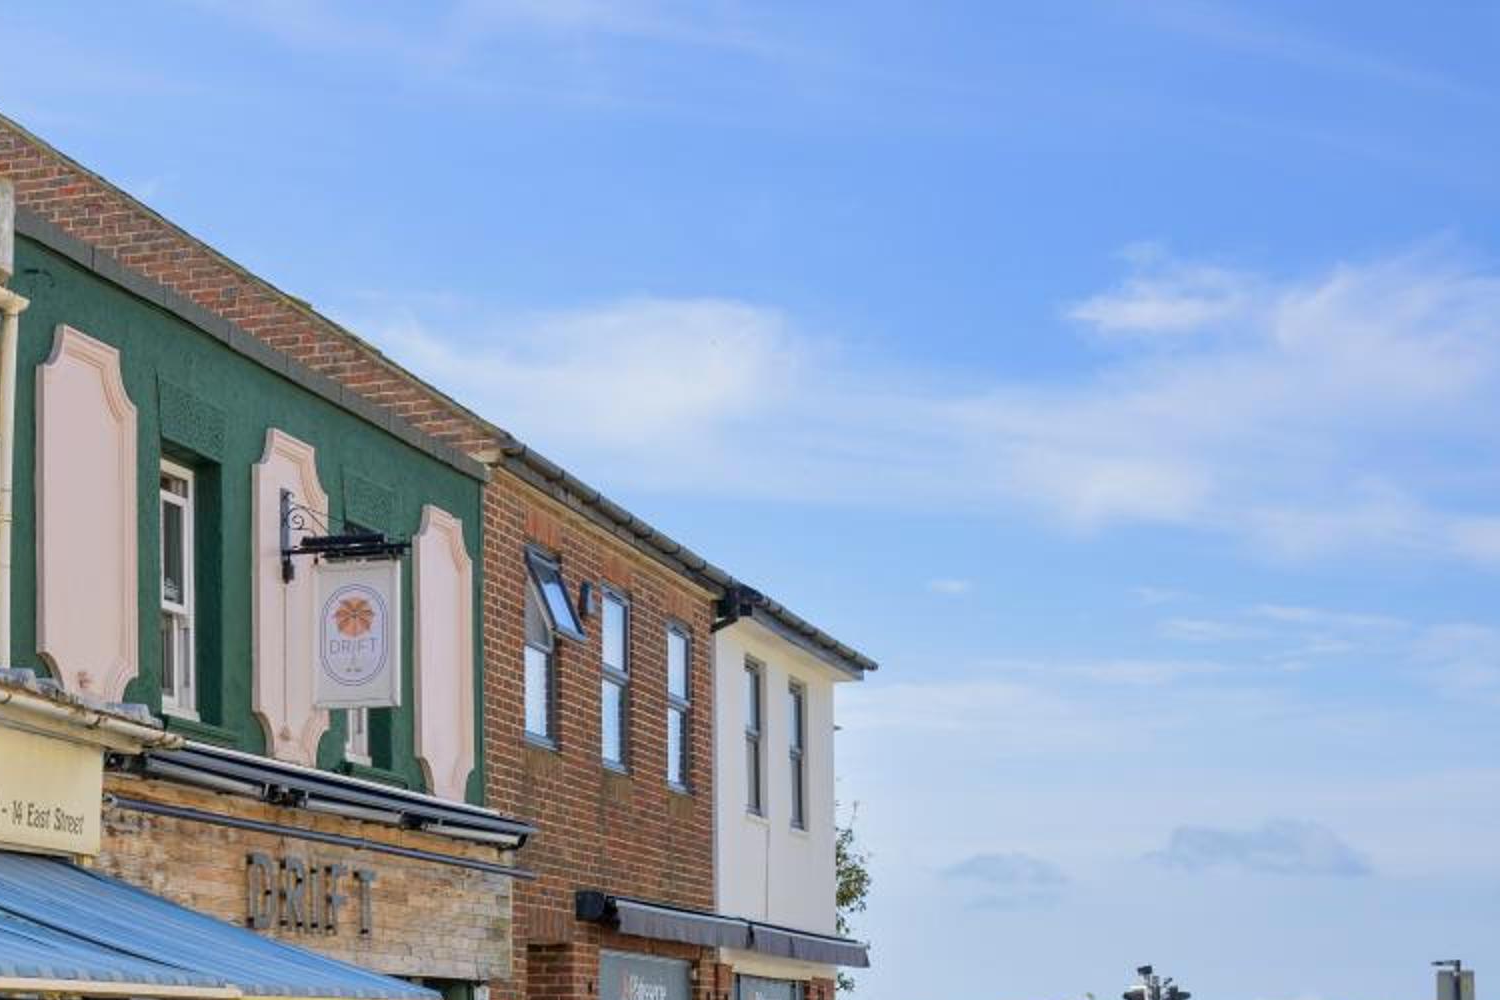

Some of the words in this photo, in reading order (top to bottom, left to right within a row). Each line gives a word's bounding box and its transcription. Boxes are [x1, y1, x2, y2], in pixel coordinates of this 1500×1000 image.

[329, 638, 377, 656] DRIFT
[27, 803, 51, 829] East
[54, 807, 85, 835] Street
[245, 852, 376, 937] DRIFT
